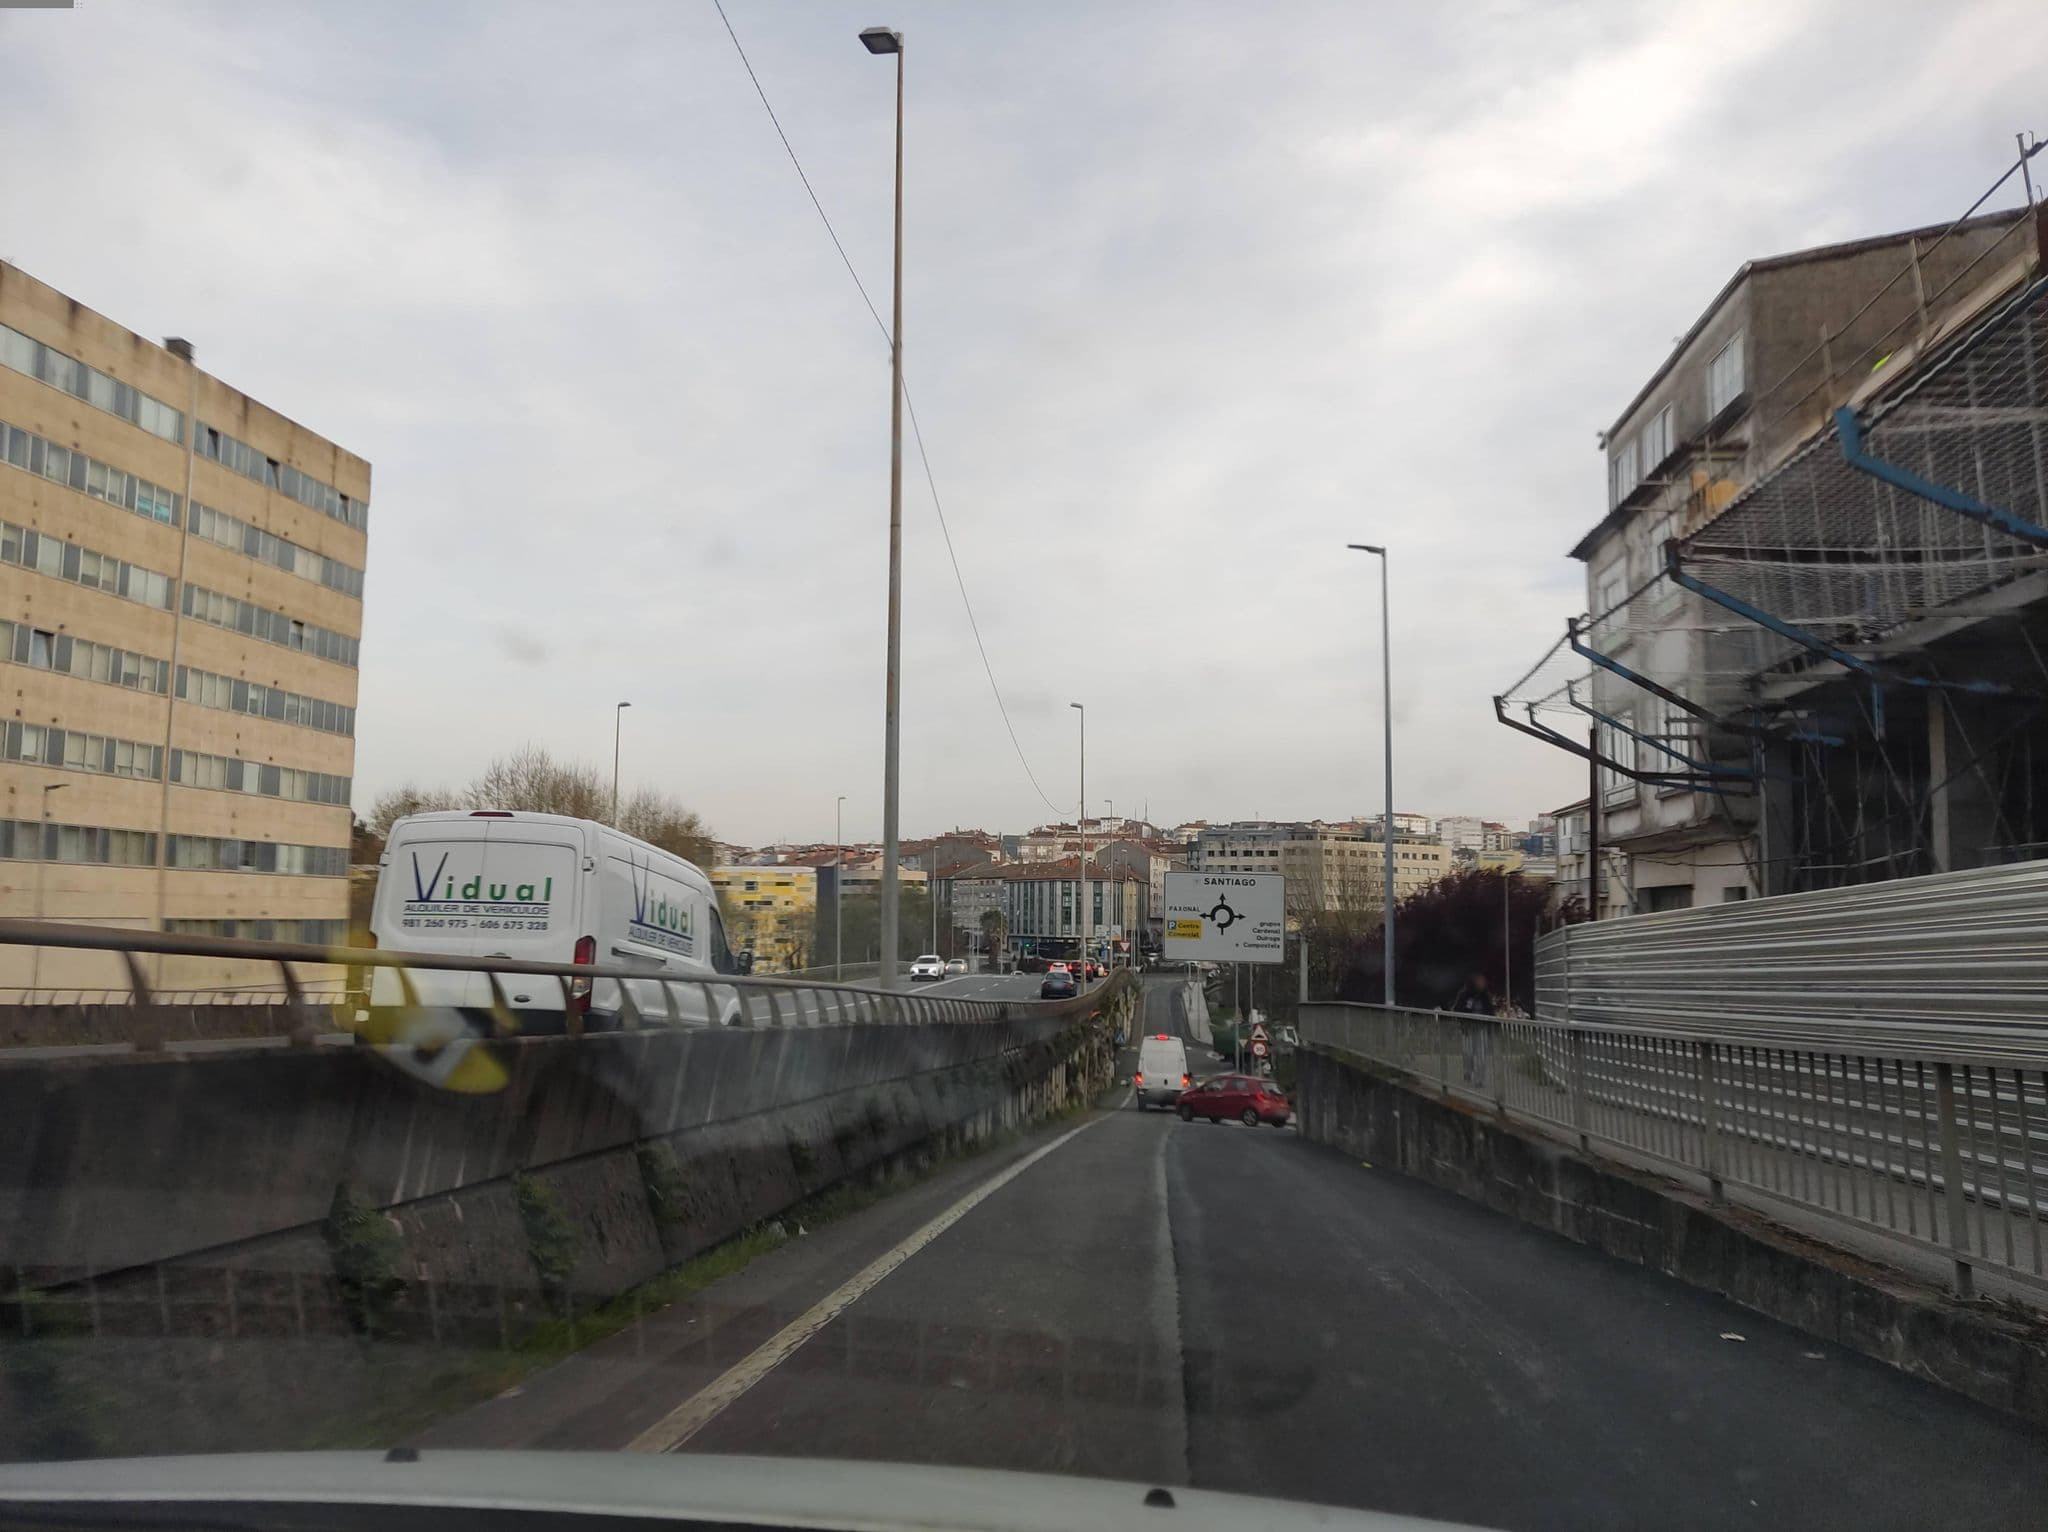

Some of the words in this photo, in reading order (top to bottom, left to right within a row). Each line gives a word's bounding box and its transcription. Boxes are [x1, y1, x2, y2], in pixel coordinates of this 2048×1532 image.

[412, 851, 552, 901] Vidual
[1203, 878, 1256, 887] SANTIAGO
[629, 847, 694, 936] Vidual
[404, 903, 460, 913] ALQUILER
[463, 905, 480, 913] DE
[484, 905, 550, 915] VEHICULOS
[402, 918, 421, 927] 981
[448, 919, 468, 928] 975
[503, 920, 524, 930] 675
[527, 921, 548, 930] 328
[1169, 920, 1176, 929] P
